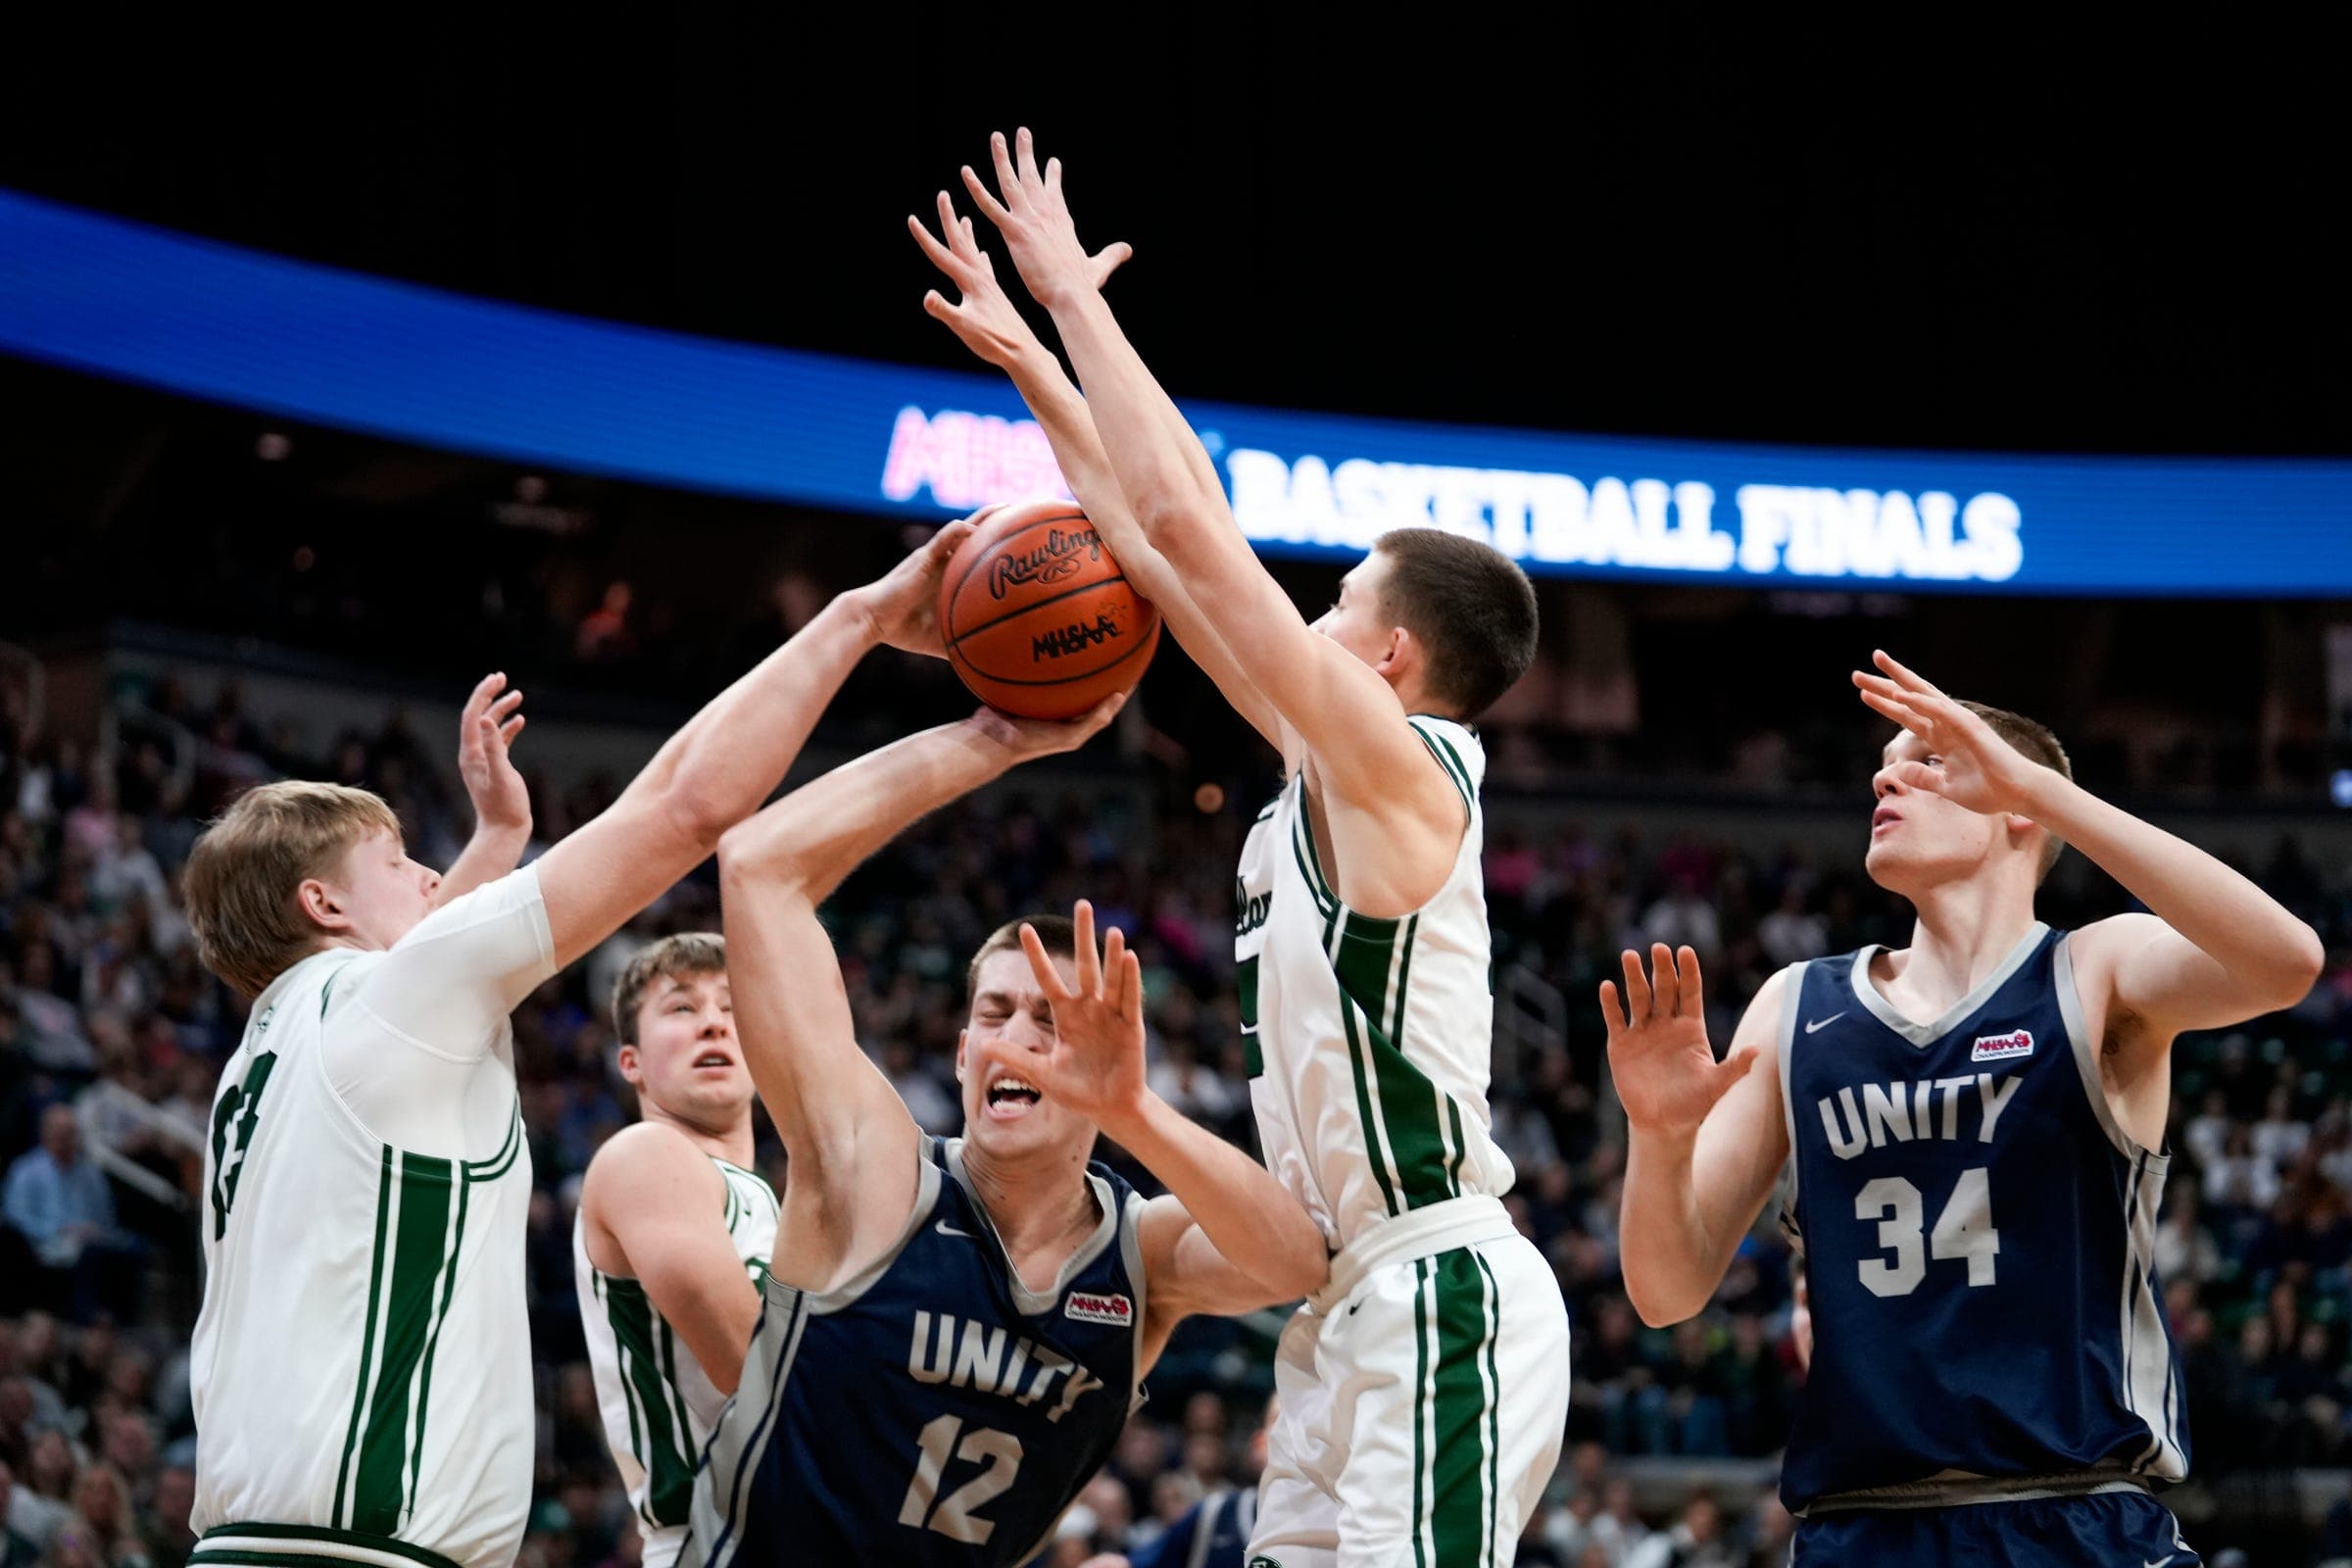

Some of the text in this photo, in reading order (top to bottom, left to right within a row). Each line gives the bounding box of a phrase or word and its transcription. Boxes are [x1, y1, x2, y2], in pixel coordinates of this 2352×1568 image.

[988, 527, 1102, 602] Rawling
[1227, 447, 1736, 572] BASKETBALL
[1737, 482, 2024, 582] FINALS
[1033, 613, 1118, 662] MHSAA
[1818, 1073, 2024, 1160] UNITY
[1854, 1166, 2000, 1298] 34
[908, 1308, 1104, 1423] UNITY
[898, 1413, 1025, 1545] 12
